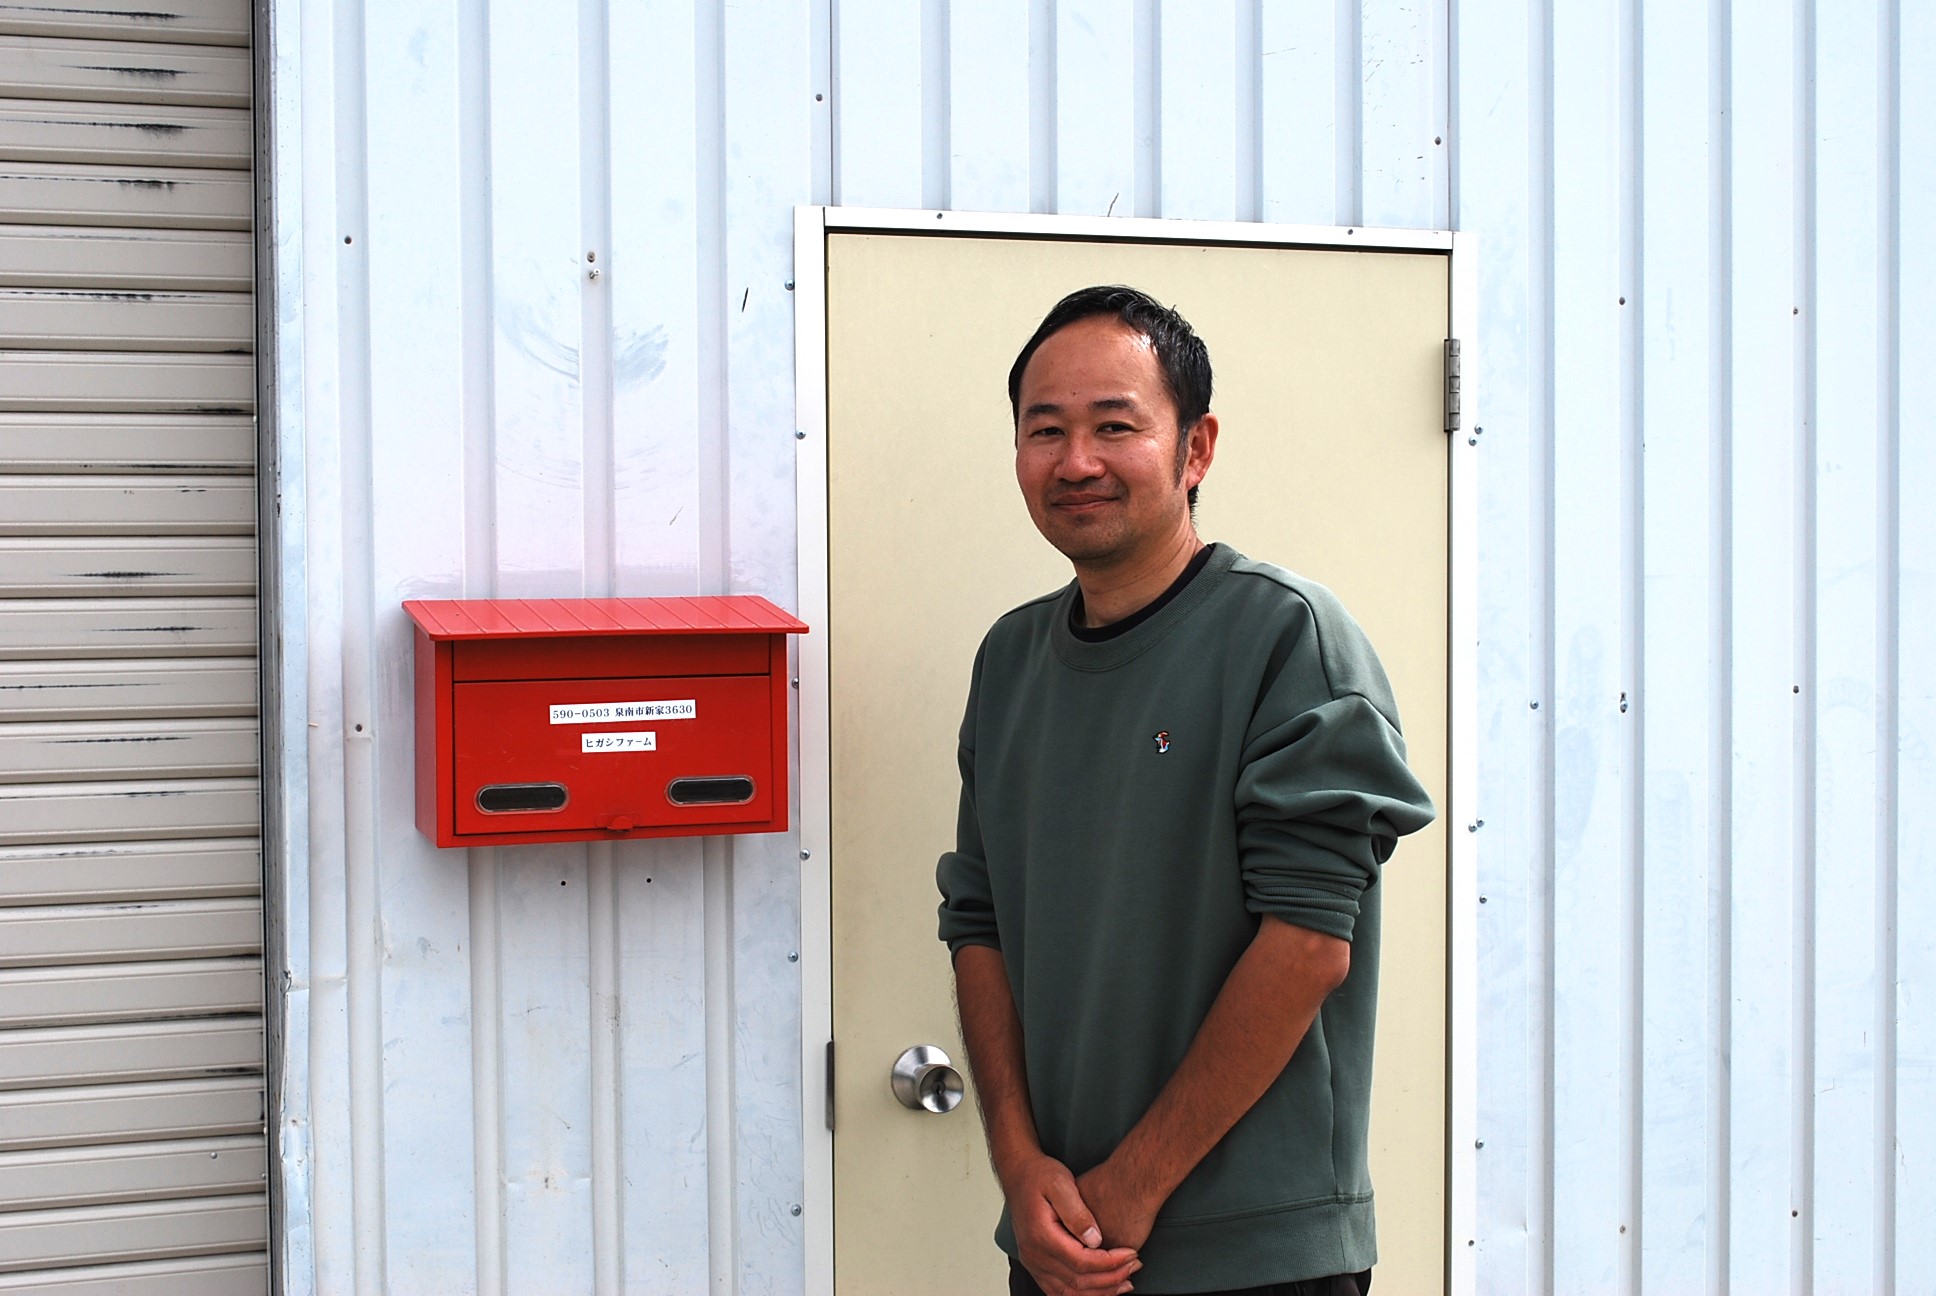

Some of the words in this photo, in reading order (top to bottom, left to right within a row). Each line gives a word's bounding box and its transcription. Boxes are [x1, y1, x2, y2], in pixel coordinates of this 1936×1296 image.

[552, 708, 610, 719] 590-0503
[615, 704, 693, 717] 泉南市新家3630
[585, 737, 652, 748] ヒガシファーム
